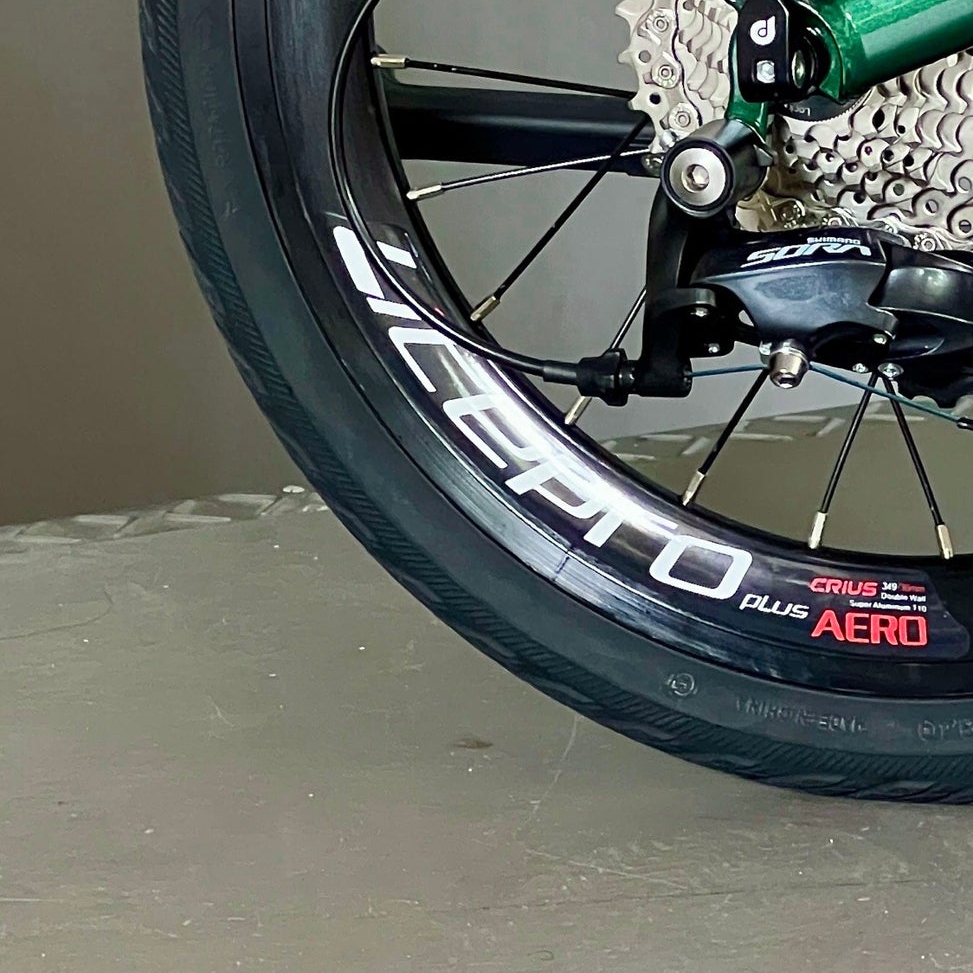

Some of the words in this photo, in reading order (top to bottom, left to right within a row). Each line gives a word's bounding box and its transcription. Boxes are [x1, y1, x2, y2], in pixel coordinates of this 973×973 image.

[806, 236, 861, 245] SHIMANO
[740, 242, 871, 268] SORA
[809, 577, 878, 597] CRIUS
[881, 581, 897, 592] 349
[849, 600, 871, 609] Super
[881, 592, 908, 601] Double
[910, 594, 926, 602] Wall
[811, 609, 927, 646] AERO
